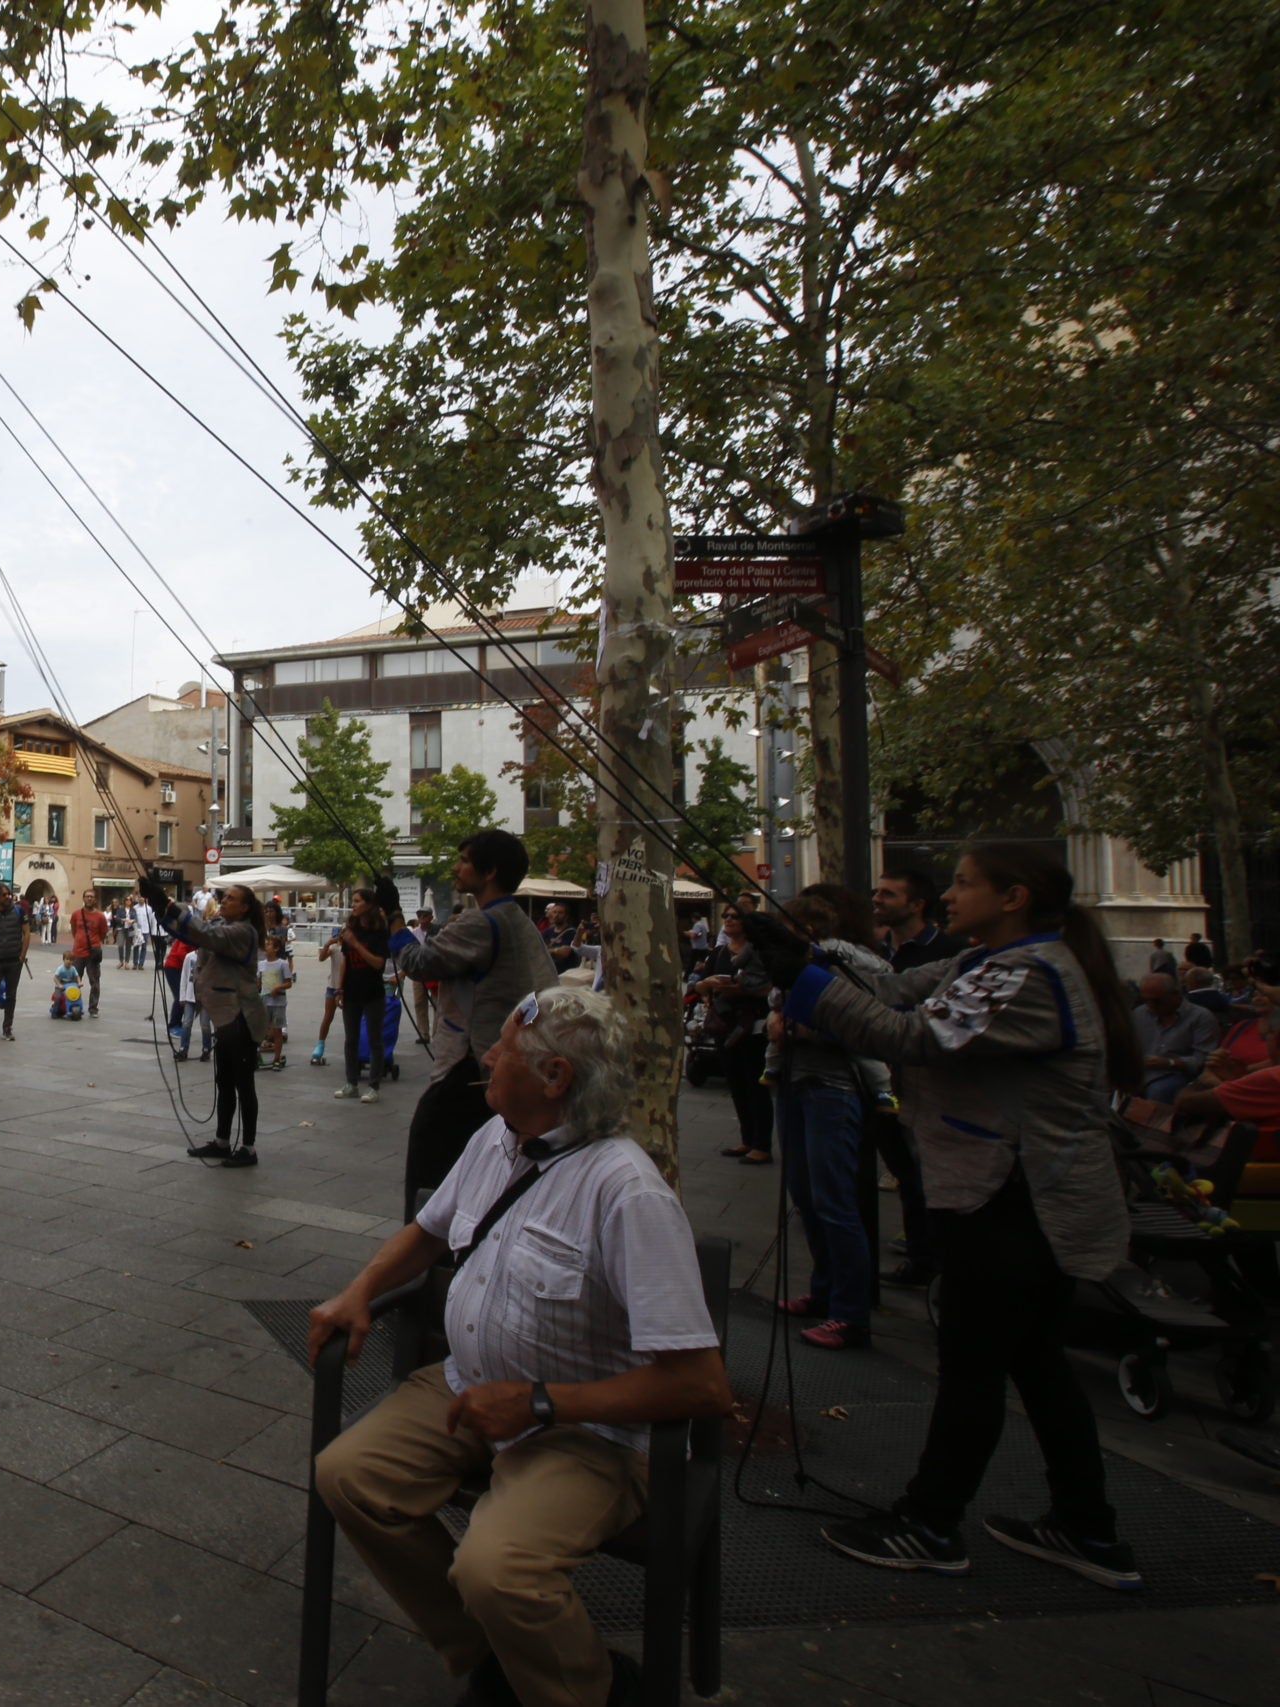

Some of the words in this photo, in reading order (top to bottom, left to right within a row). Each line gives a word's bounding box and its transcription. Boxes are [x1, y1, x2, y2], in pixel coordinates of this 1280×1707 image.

[706, 540, 738, 551] Raval
[739, 540, 754, 551] de
[756, 540, 817, 551] Montserrat
[701, 565, 727, 576] Torre
[729, 565, 745, 576] del
[747, 565, 775, 577] Palau
[783, 566, 817, 577] Centre
[674, 577, 723, 589] erpretació
[725, 578, 739, 588] de
[741, 578, 751, 588] la
[753, 578, 770, 588] Vila
[773, 578, 817, 588] Medieval
[28, 861, 55, 871] PONSA
[618, 859, 642, 871] PER
